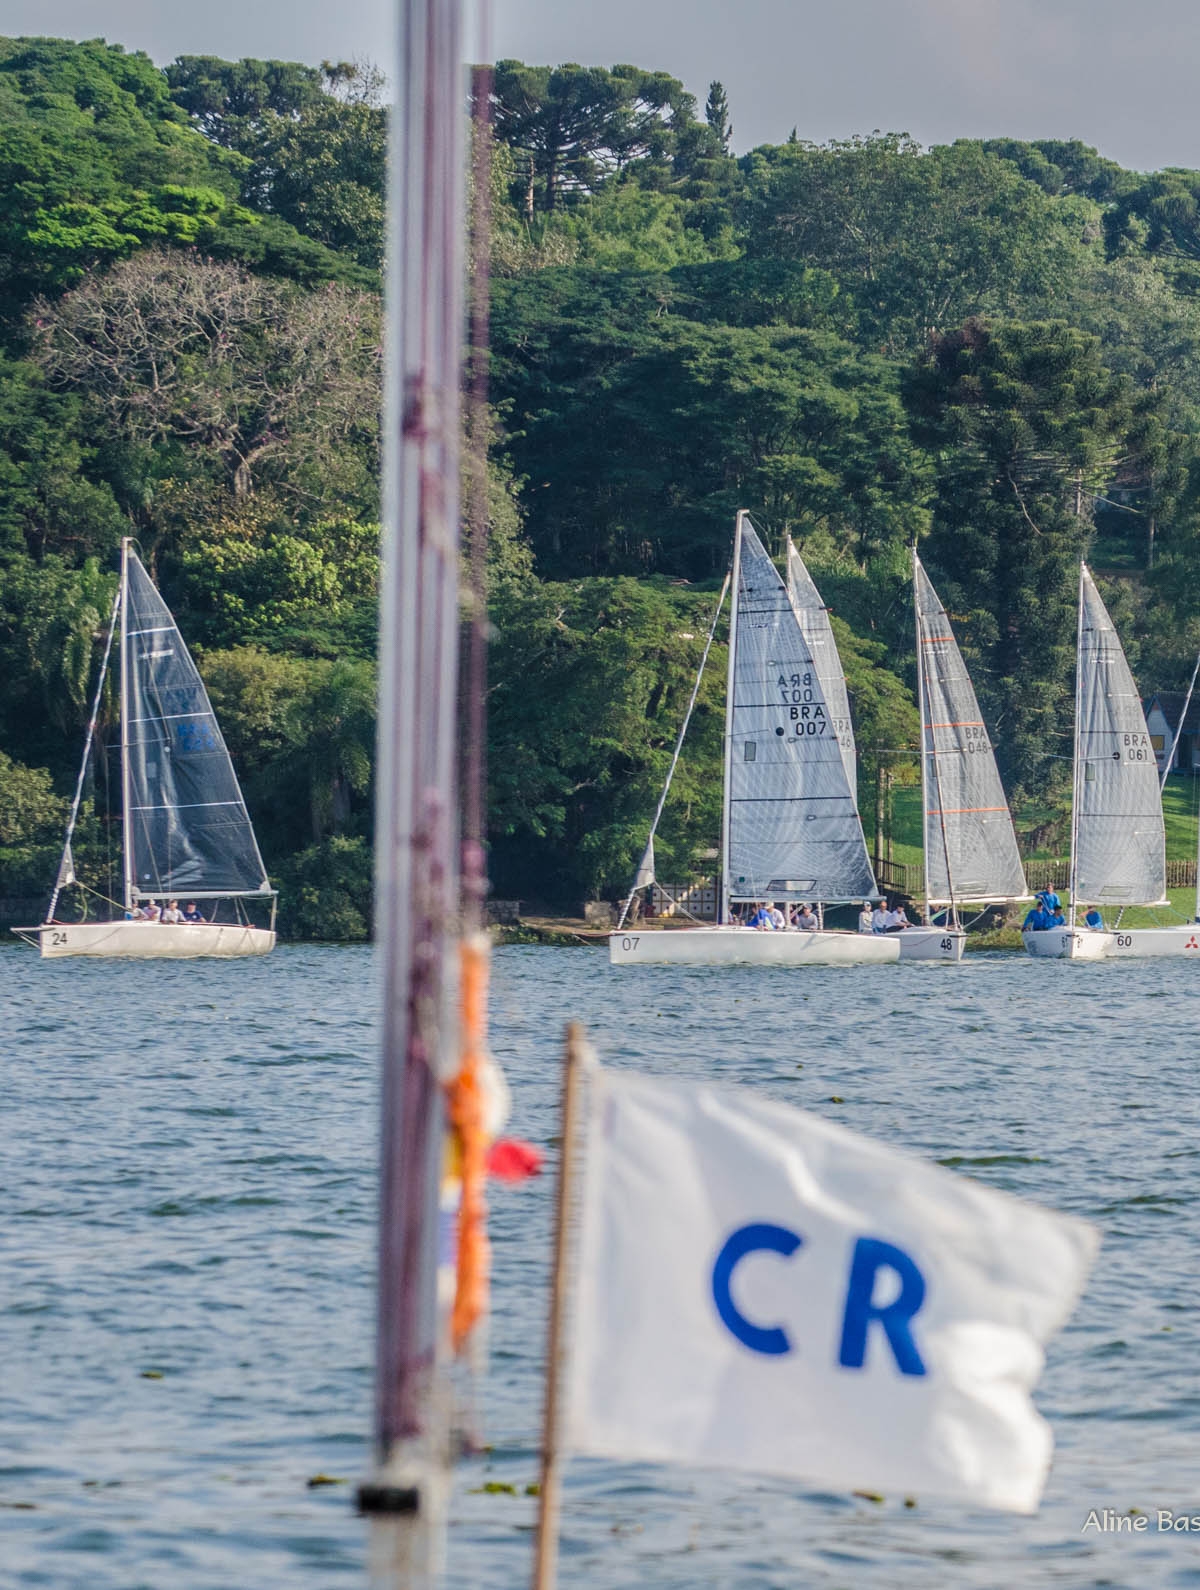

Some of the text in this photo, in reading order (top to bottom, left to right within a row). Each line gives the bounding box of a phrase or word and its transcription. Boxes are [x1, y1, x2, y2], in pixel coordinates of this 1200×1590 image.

[790, 706, 825, 720] BRA
[795, 721, 827, 736] 007
[965, 727, 987, 739] BRA
[1124, 734, 1148, 747] BRA
[968, 742, 988, 754] 048
[1128, 749, 1148, 761] 061
[52, 932, 68, 946] 24
[622, 937, 641, 951] 07
[940, 938, 953, 951] 48
[1117, 935, 1132, 947] 60
